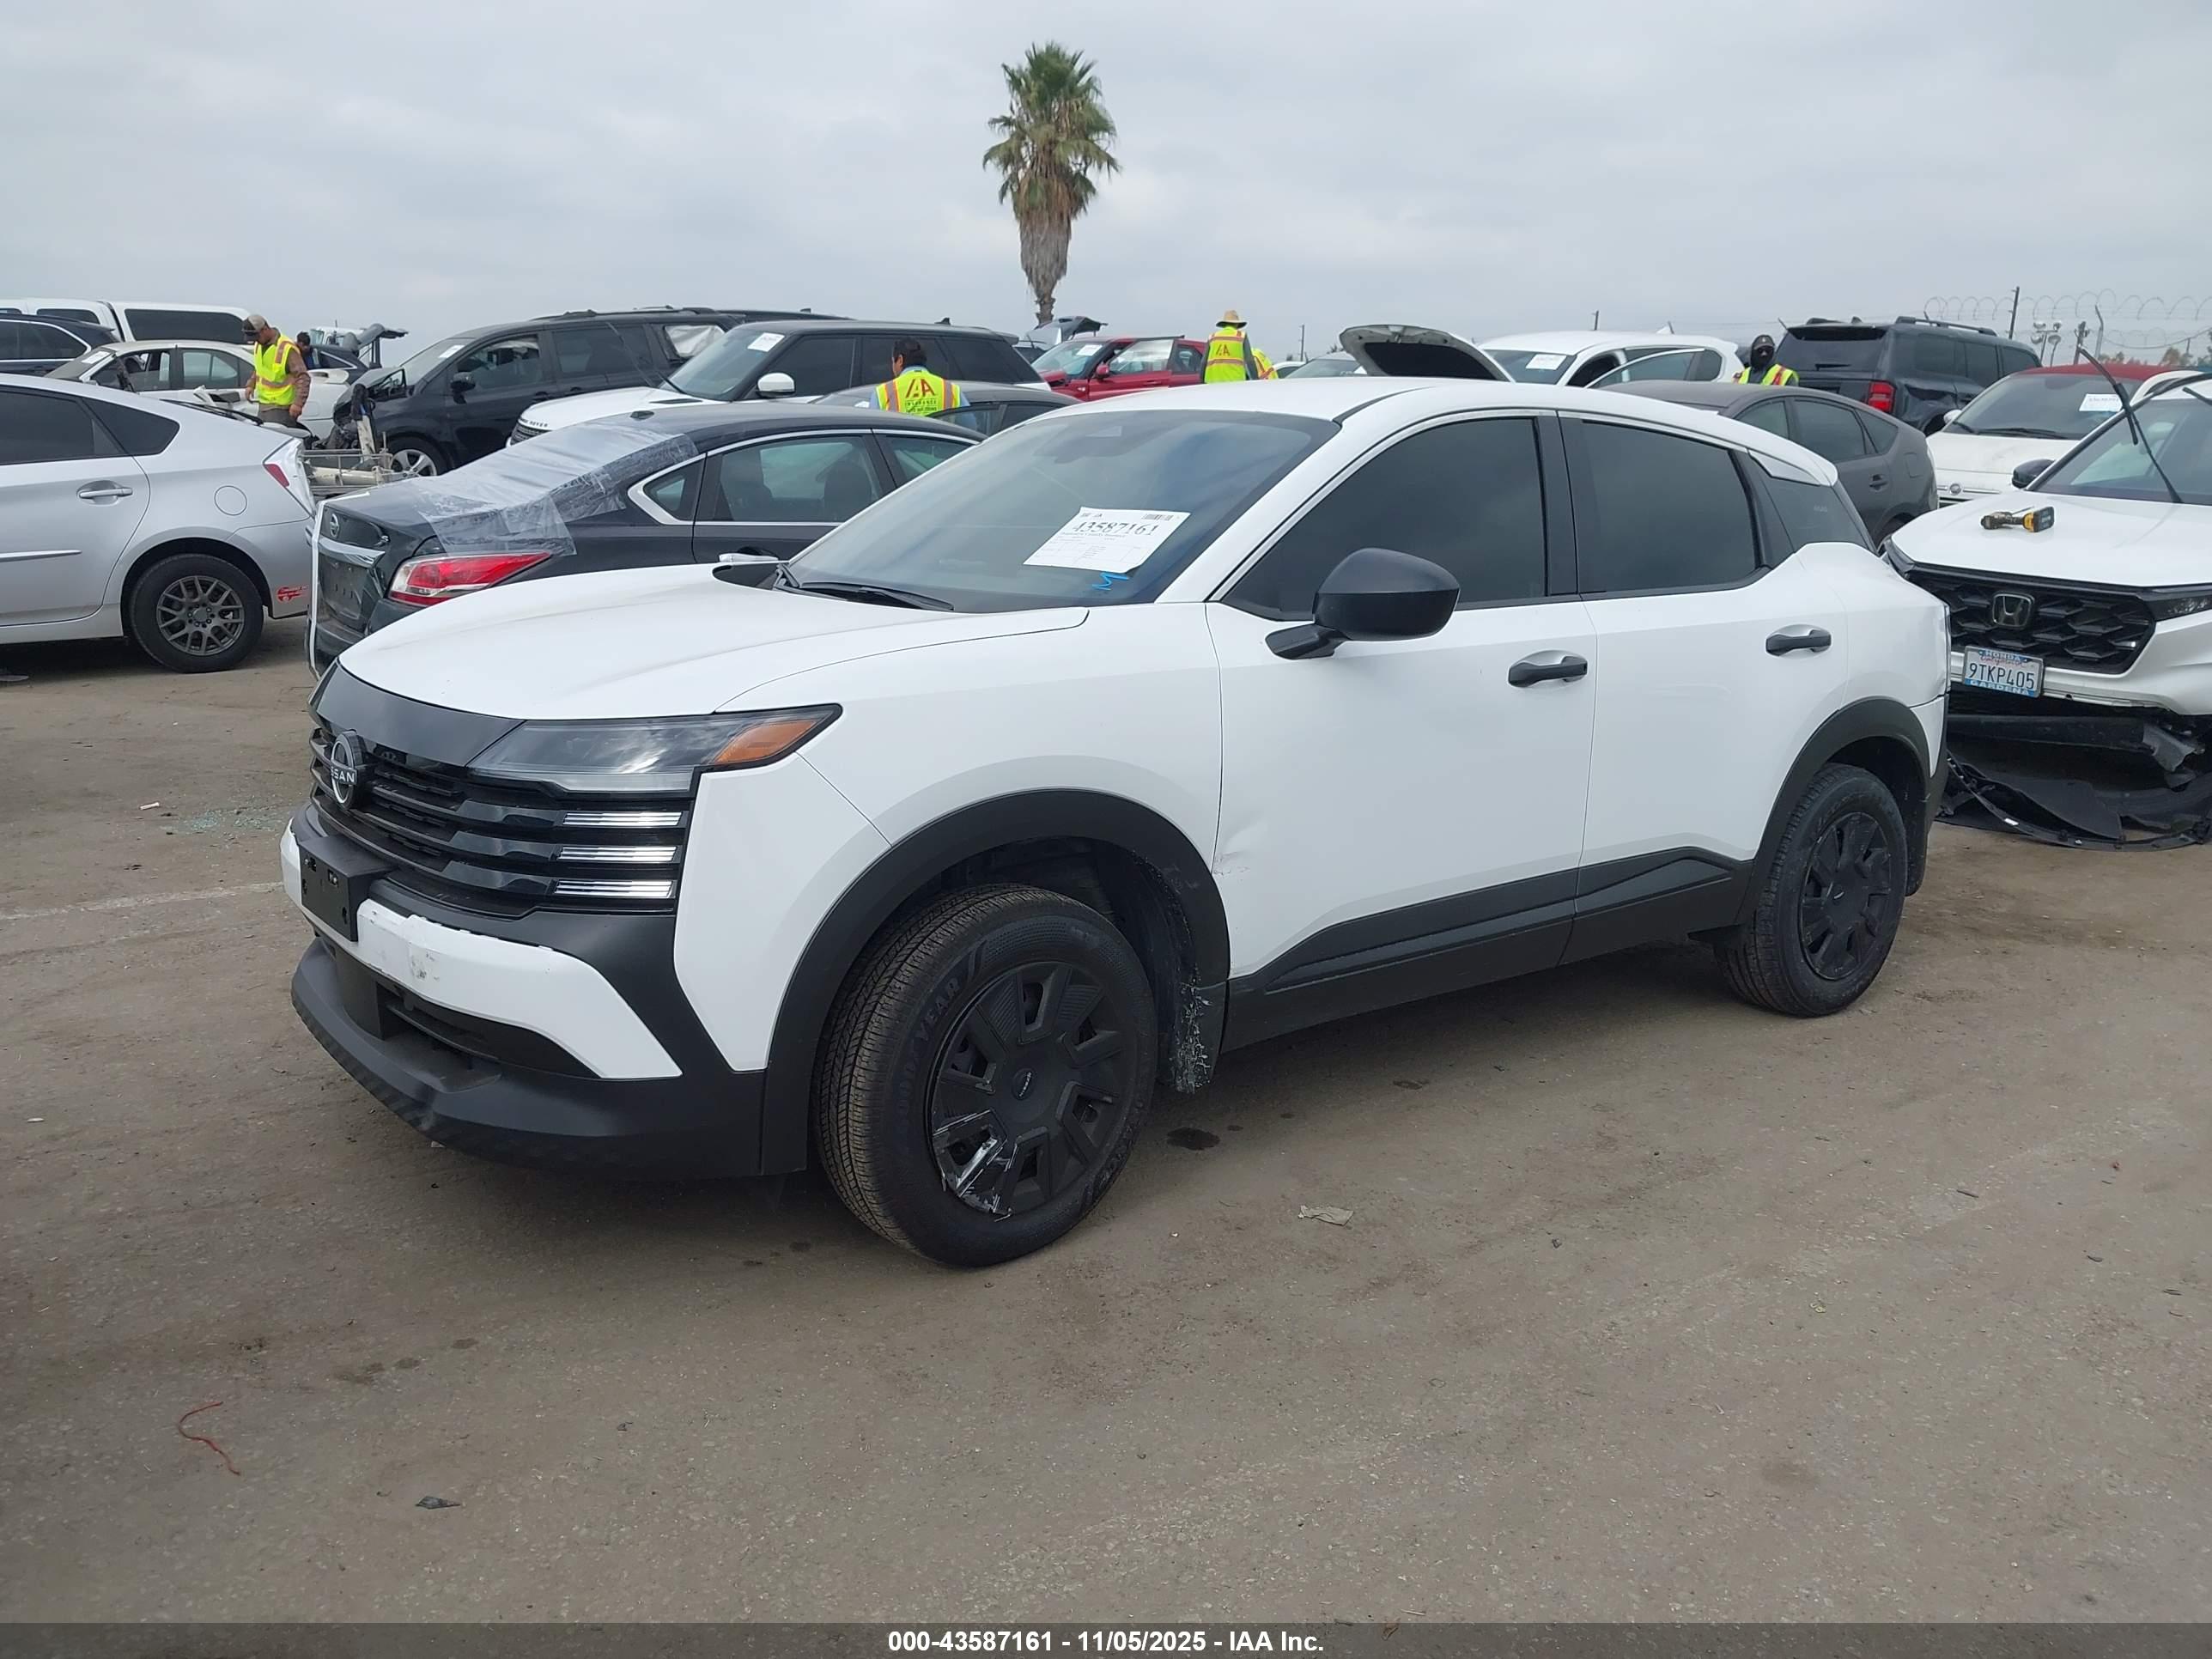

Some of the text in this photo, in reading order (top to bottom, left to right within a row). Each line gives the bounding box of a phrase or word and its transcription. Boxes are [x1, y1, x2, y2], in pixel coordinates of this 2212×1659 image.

[1073, 521, 1159, 536] 43587161
[1985, 649, 2021, 661] HONDA
[1969, 662, 2035, 690] 9TKP405
[1969, 678, 2030, 696] GARDENA
